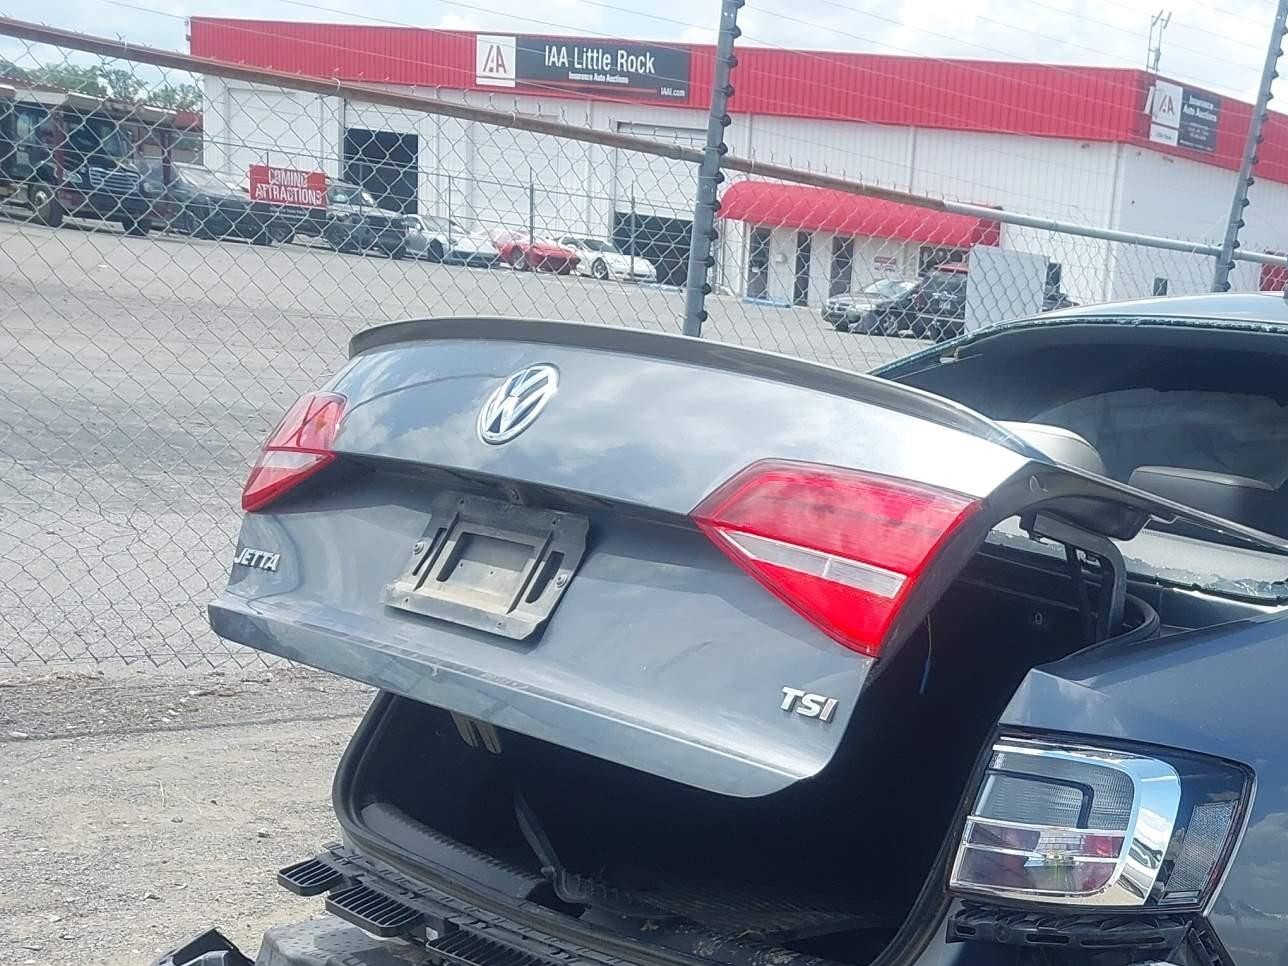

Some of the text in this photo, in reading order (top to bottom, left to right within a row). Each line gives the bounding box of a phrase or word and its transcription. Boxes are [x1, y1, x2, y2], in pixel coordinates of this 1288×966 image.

[544, 45, 656, 74] IAA Little Rock
[255, 183, 322, 206] ATTRACTIONS
[234, 547, 281, 572] JETTA
[780, 686, 839, 722] TSI
